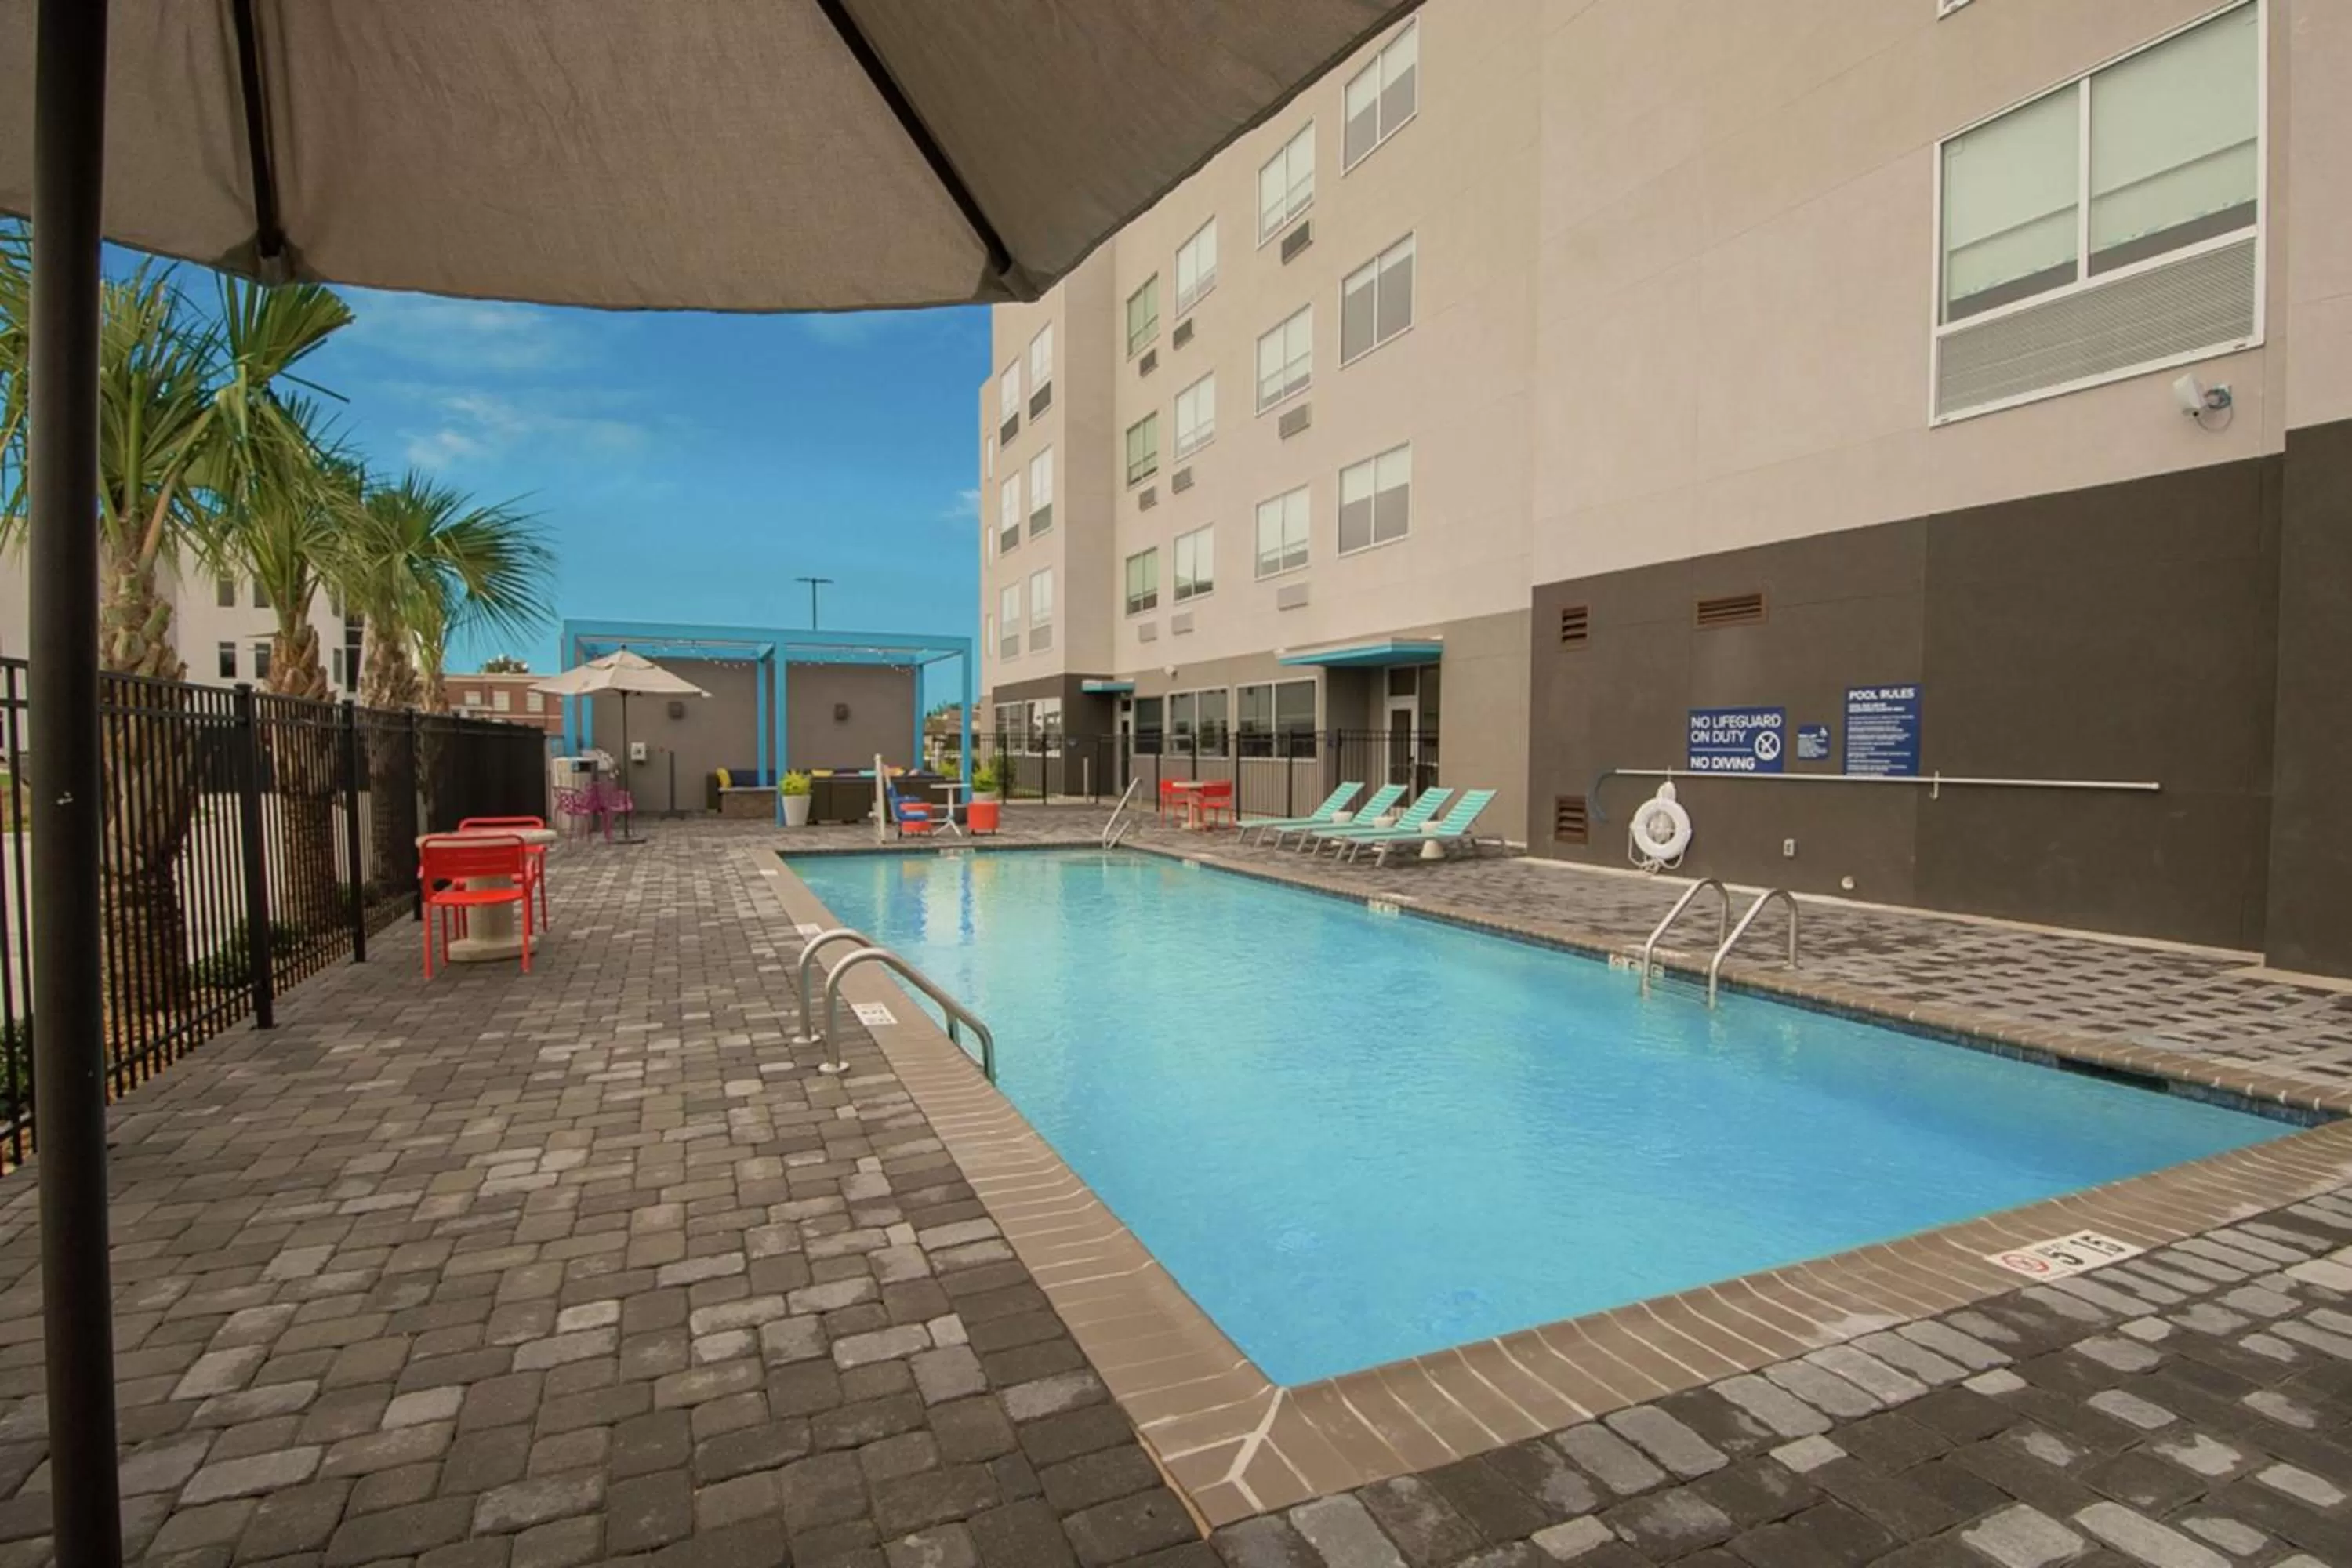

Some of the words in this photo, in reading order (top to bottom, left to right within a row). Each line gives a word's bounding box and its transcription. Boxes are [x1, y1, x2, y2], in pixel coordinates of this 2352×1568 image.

[1849, 689, 1878, 700] POOL
[1879, 688, 1915, 699] RULES
[1690, 716, 1710, 729] NO
[1712, 713, 1782, 728] LIFEGUARD
[1690, 731, 1710, 743] ON
[1712, 729, 1747, 743] DUTY
[1690, 757, 1709, 770] NO
[1711, 757, 1755, 771] DIVING
